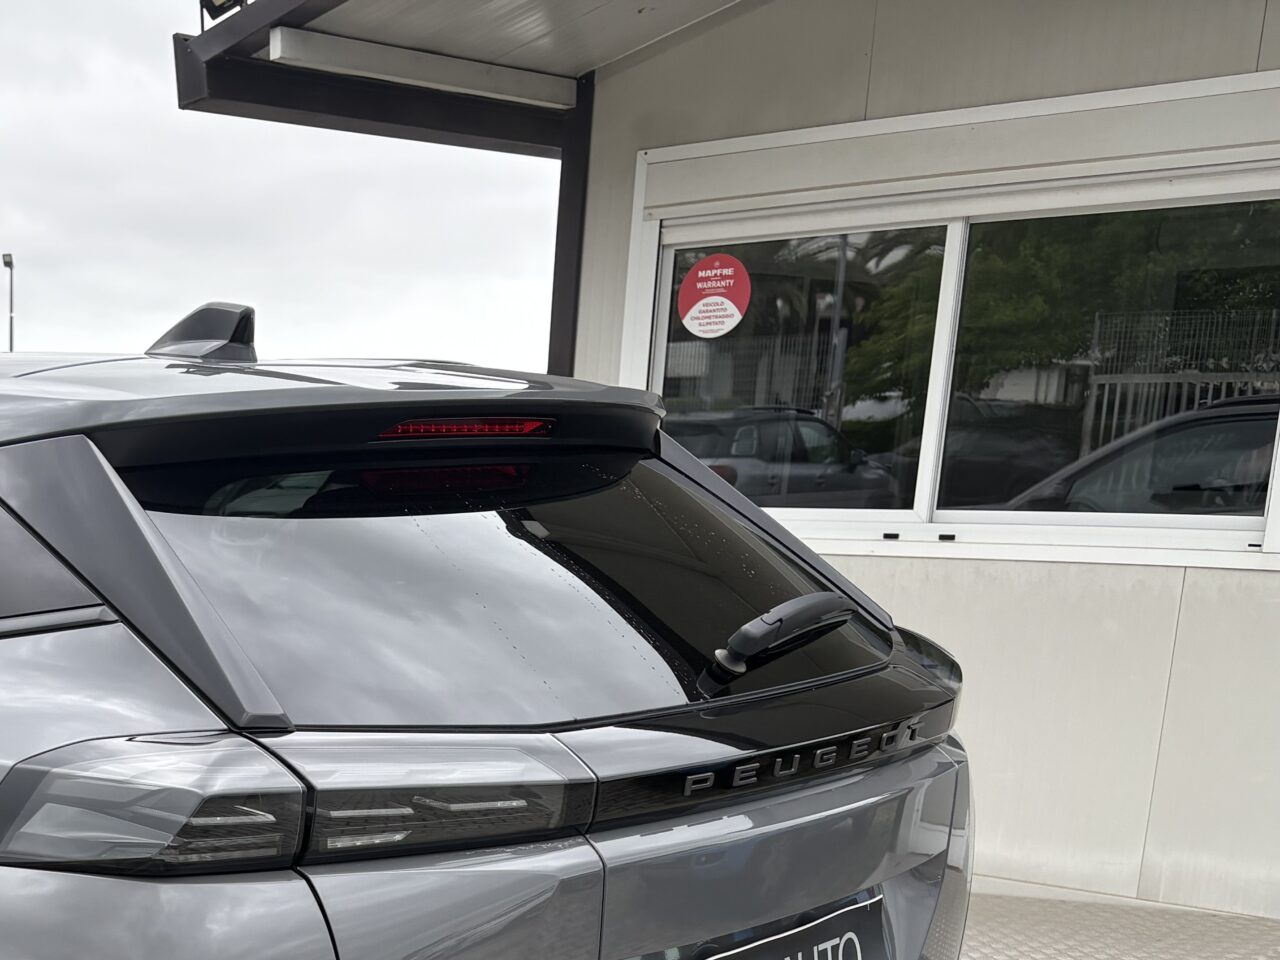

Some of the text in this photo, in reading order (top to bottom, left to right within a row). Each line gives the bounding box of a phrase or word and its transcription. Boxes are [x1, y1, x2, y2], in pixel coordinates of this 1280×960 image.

[697, 267, 735, 278] MAPFRE
[696, 279, 735, 289] WARRANTY
[683, 721, 925, 796] PEUGEOT
